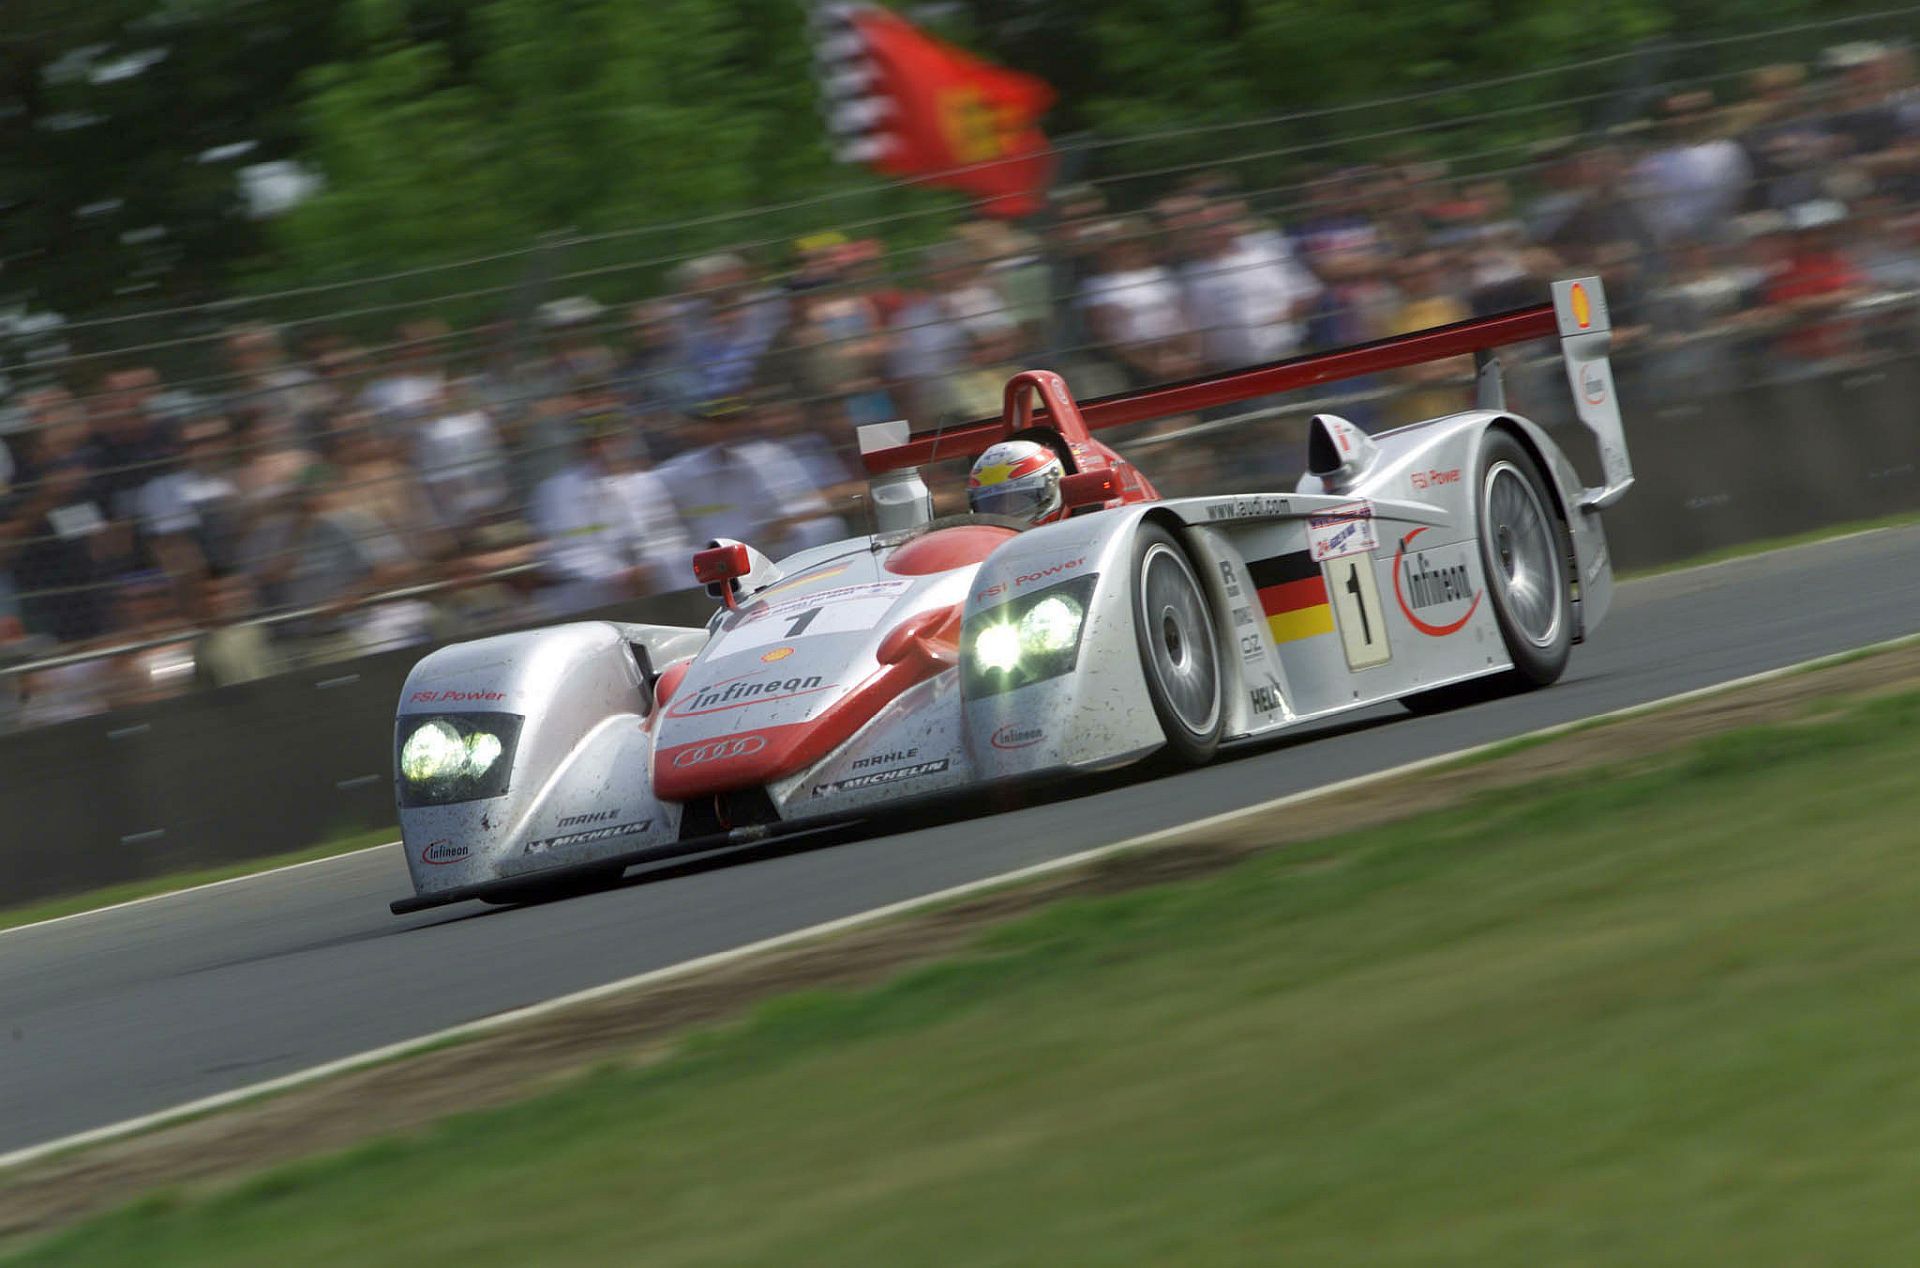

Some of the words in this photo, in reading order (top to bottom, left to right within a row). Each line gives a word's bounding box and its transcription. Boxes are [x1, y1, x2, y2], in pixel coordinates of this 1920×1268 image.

[1205, 497, 1291, 520] www.audi.com
[1014, 556, 1087, 587] Power
[1346, 562, 1373, 646] 1
[784, 606, 824, 638] 1
[410, 691, 439, 702] FSI
[443, 689, 507, 702] Power
[852, 748, 919, 770] MAHLE
[843, 760, 945, 789] MICHELIN
[557, 808, 621, 828] MAHLE
[550, 820, 648, 848] MICHELIN
